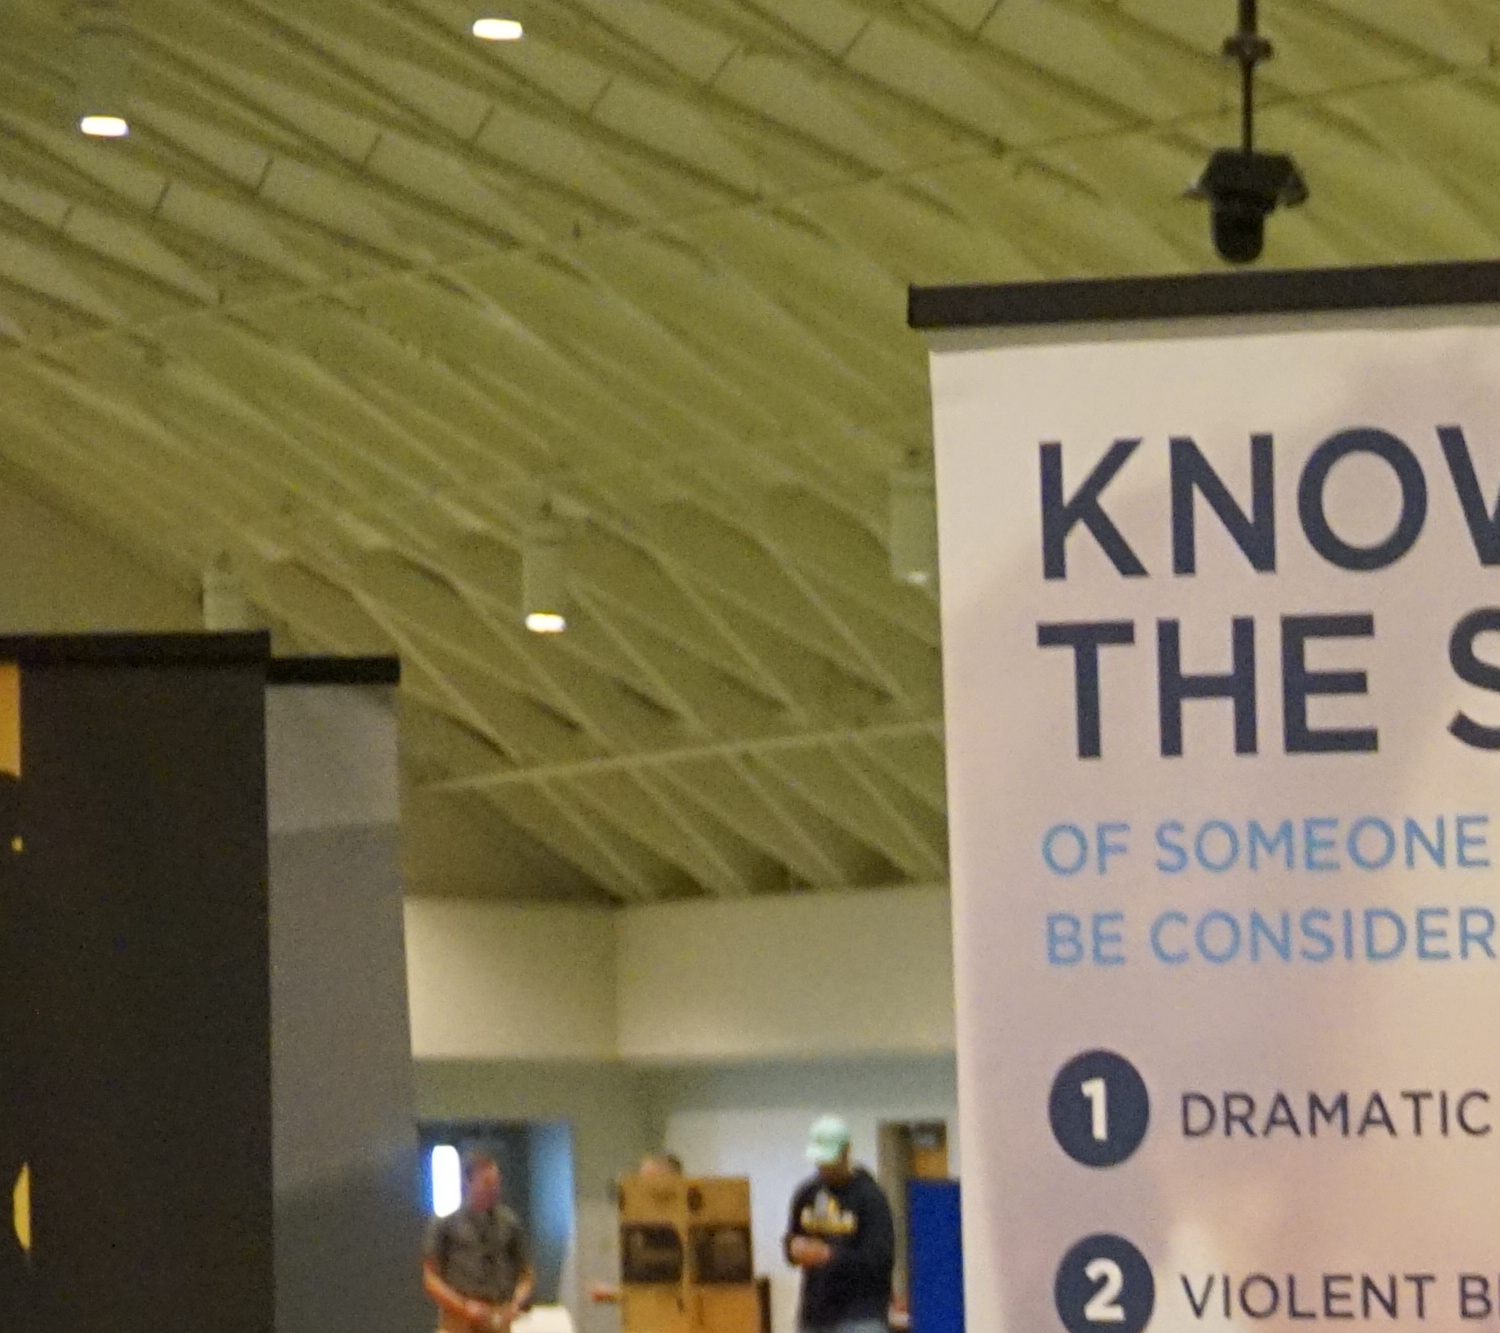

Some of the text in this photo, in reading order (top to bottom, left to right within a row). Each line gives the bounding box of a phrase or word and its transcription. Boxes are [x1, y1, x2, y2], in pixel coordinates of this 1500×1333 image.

[1036, 612, 1379, 760] THE
[1040, 821, 1131, 878] OF
[1154, 813, 1492, 875] SOMEONE
[1045, 909, 1127, 968] BE
[1081, 1077, 1108, 1141] 1
[1180, 1089, 1492, 1139] DRAMATIC
[1084, 1257, 1125, 1322] 2
[1179, 1272, 1437, 1321] VIOLENT
